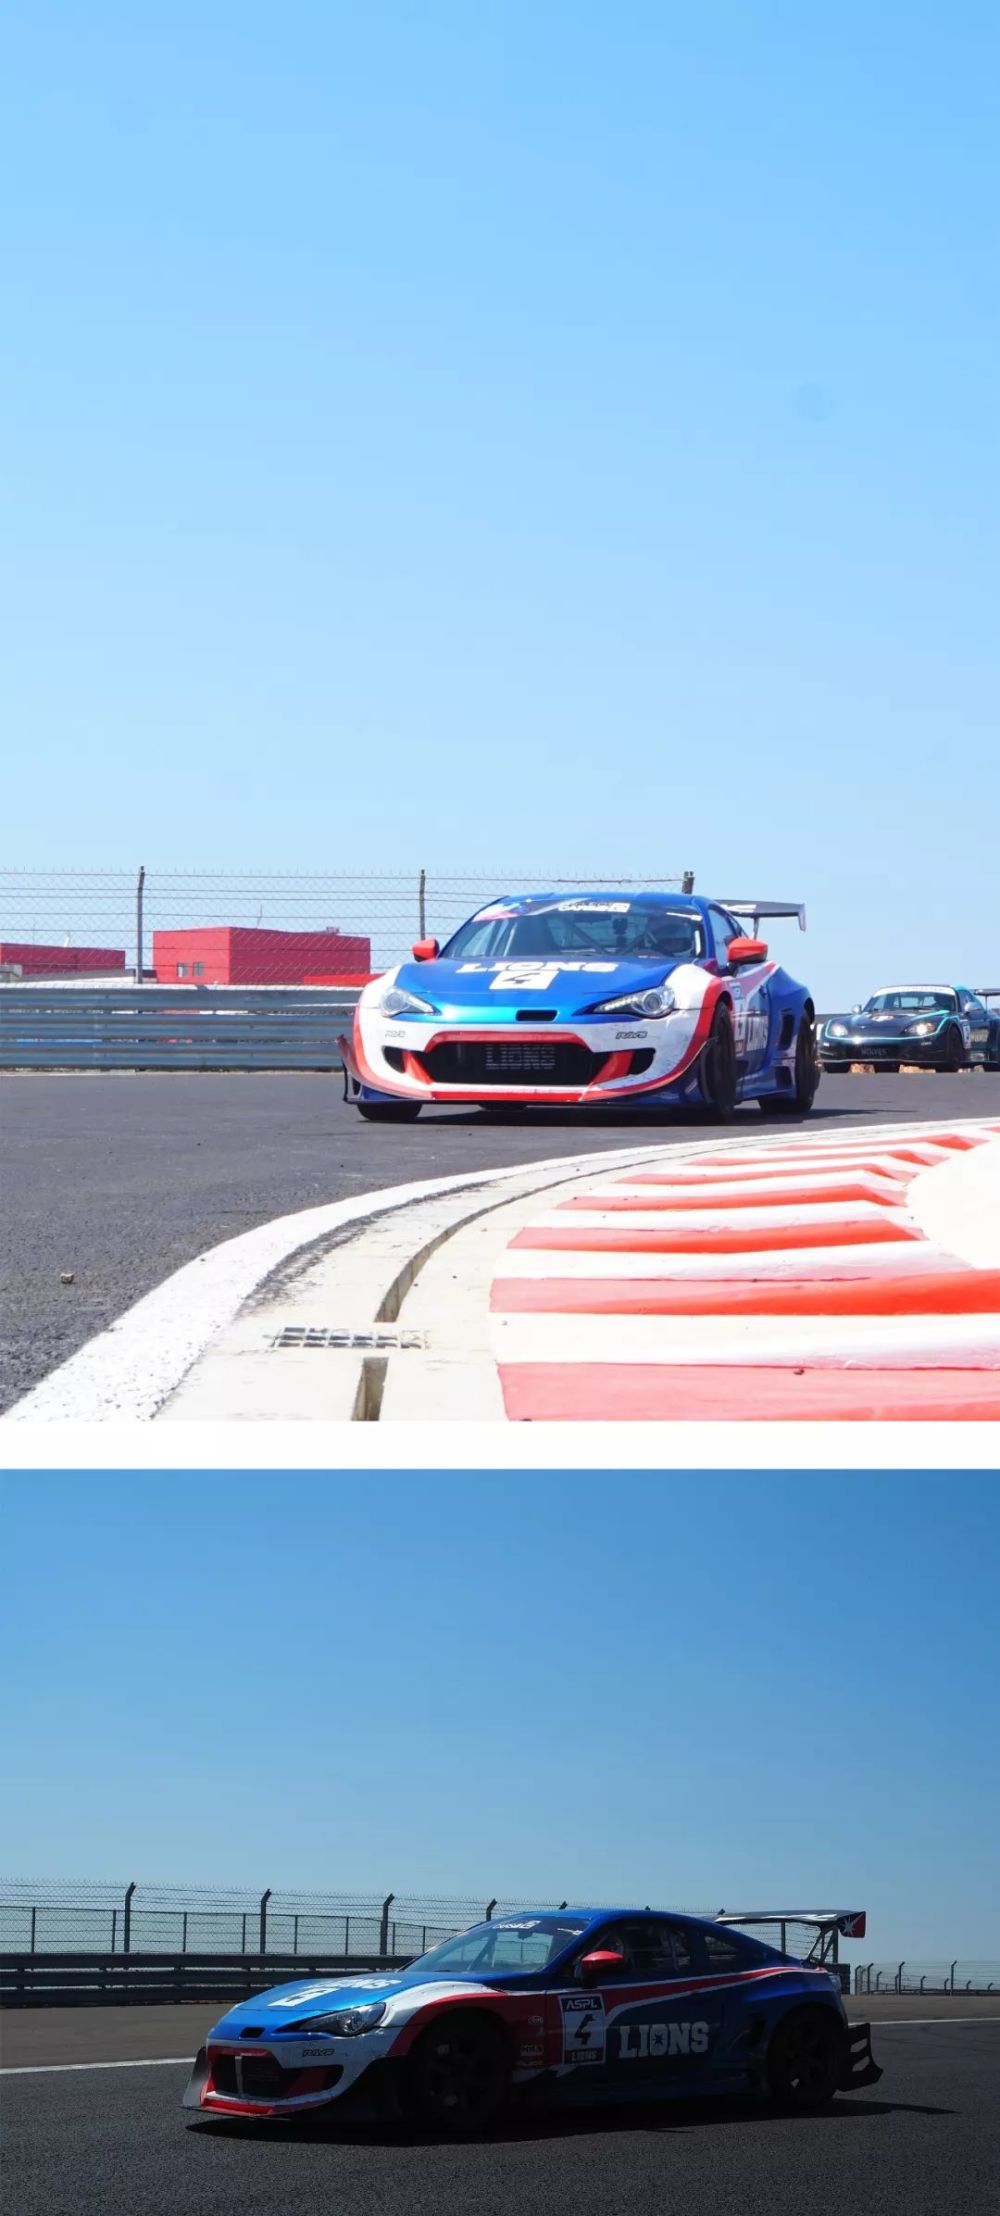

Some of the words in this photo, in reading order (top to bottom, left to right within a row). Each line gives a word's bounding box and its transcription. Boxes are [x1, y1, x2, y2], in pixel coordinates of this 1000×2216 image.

[456, 961, 619, 974] LIONS
[485, 1043, 557, 1071] LIONS
[565, 1998, 598, 2010] ASPL
[574, 2013, 598, 2046] 4
[619, 2021, 710, 2059] LIONS
